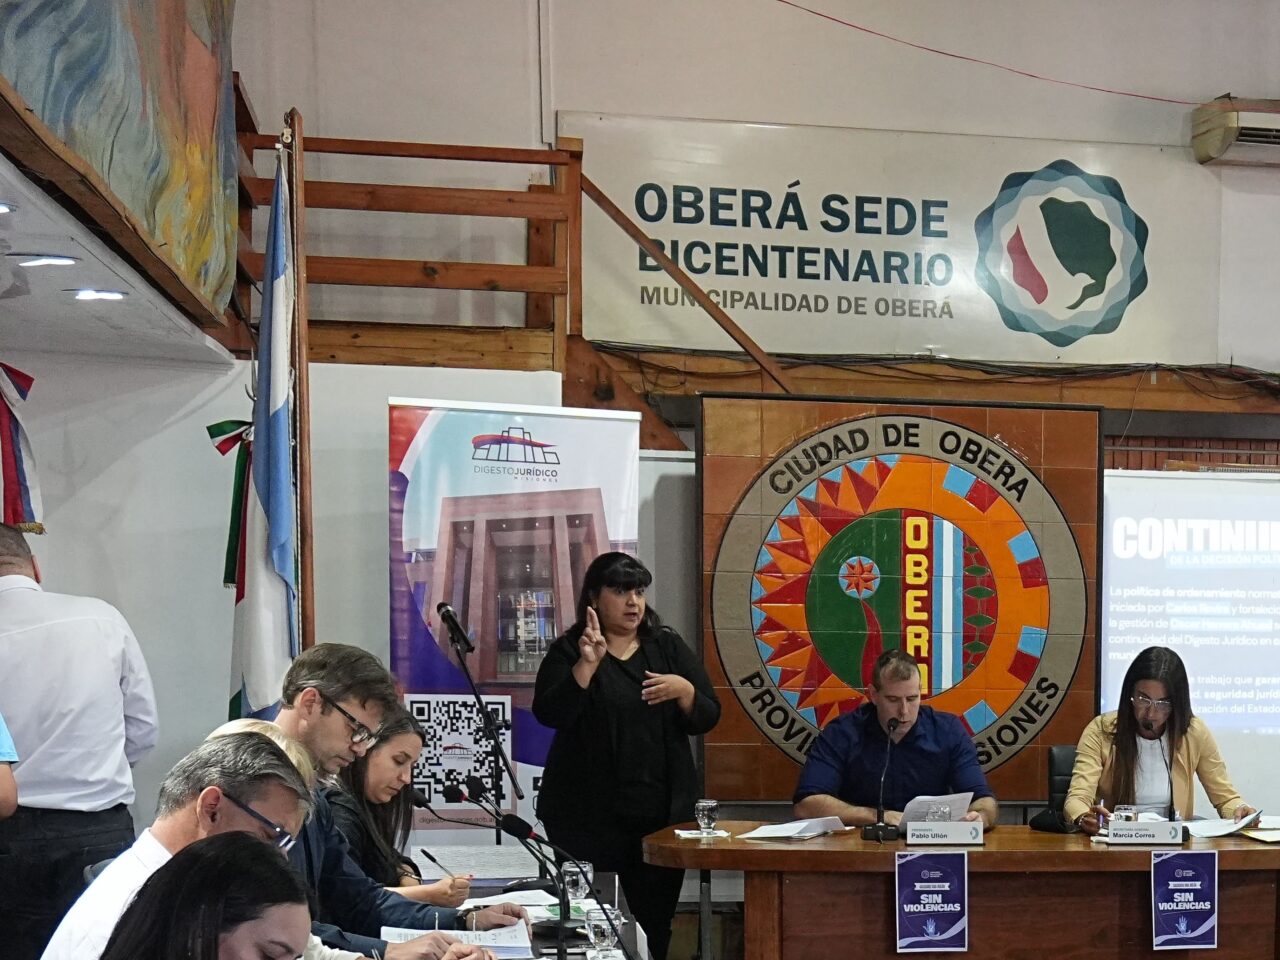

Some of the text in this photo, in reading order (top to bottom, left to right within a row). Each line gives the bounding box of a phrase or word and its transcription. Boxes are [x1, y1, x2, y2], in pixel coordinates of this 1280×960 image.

[634, 179, 949, 238] OBERÁ SEDE
[638, 238, 954, 287] BICENTENARIO
[640, 285, 954, 319] MUNCIPALIDAD DE OBERÁ
[768, 423, 1030, 503] CIUDAD DE OBERA
[1109, 586, 1122, 597] La
[1123, 585, 1160, 600] política
[1162, 587, 1175, 598] de
[1176, 587, 1246, 600] ordenamiento
[1109, 602, 1146, 613] iniciada
[1147, 604, 1165, 616] por
[1108, 618, 1117, 628] la
[1118, 617, 1154, 631] gestión
[1155, 618, 1169, 629] de
[1108, 633, 1167, 645] continuidad
[1167, 634, 1183, 645] del
[1184, 635, 1221, 649] Digesto
[1260, 638, 1272, 647] en
[1197, 675, 1232, 686] trabajo
[1233, 676, 1253, 686] que
[1204, 689, 1255, 701] seguridad
[1230, 703, 1245, 714] del
[739, 671, 1060, 766] PROVI SIONES
[920, 893, 942, 904] SIN
[1173, 892, 1194, 902] SIN
[903, 903, 961, 912] VIOLENCIAS
[1158, 901, 1211, 910] VIOLENCIAS
